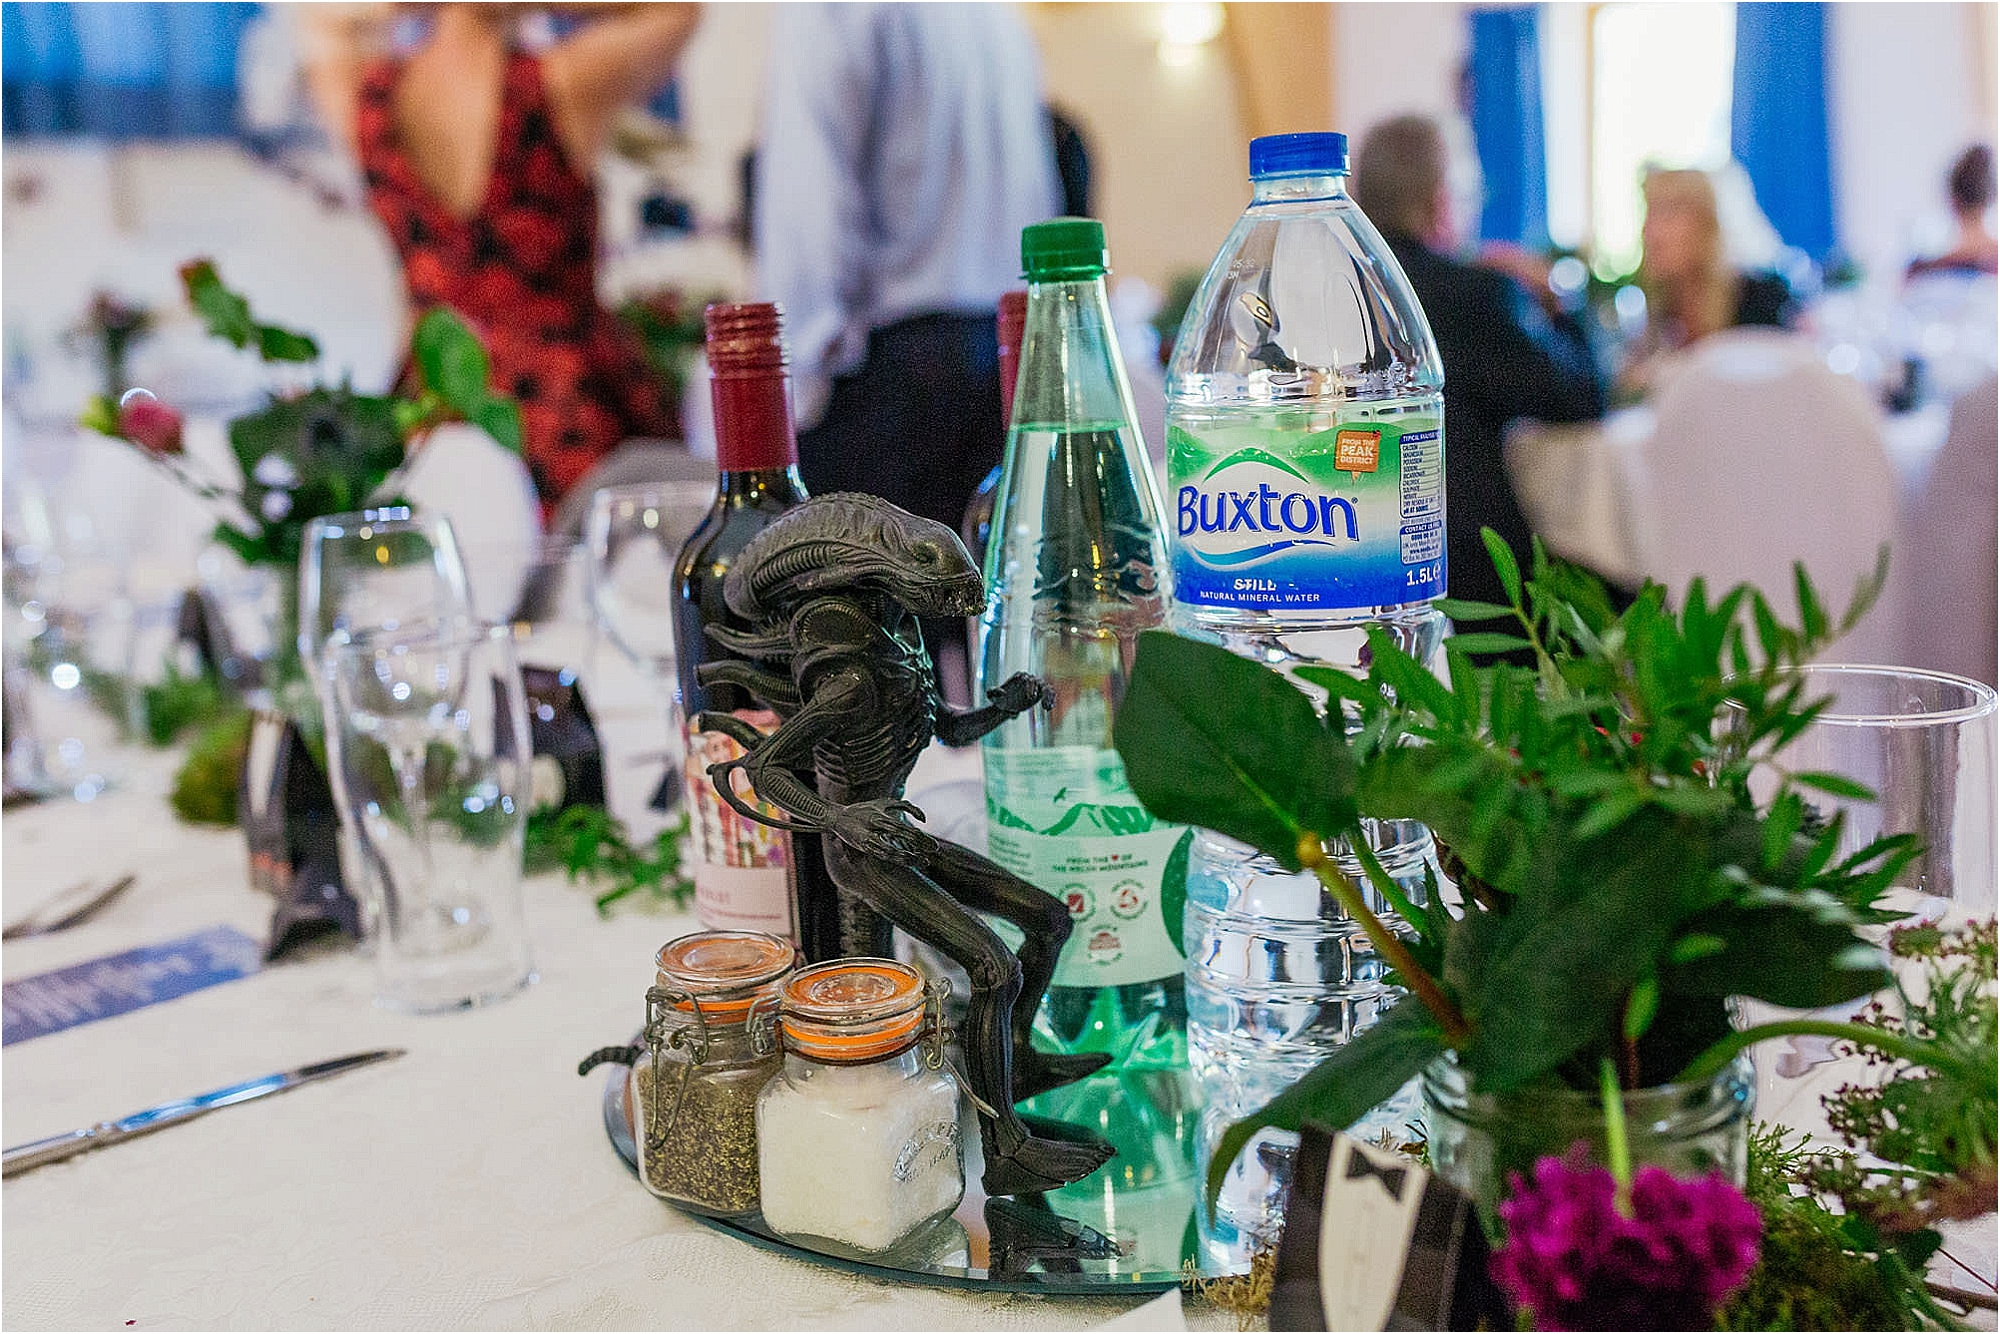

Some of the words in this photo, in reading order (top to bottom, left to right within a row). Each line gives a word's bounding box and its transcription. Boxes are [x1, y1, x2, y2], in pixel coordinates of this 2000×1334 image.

[1342, 438, 1361, 446] FROM
[1341, 445, 1374, 457] PEAK
[1340, 455, 1374, 465] DISTRICT
[1179, 483, 1360, 542] Buxton
[1234, 579, 1276, 591] STILL
[1200, 591, 1235, 601] NATURAL
[1238, 593, 1282, 602] MINERAL
[1285, 593, 1320, 602] WATER
